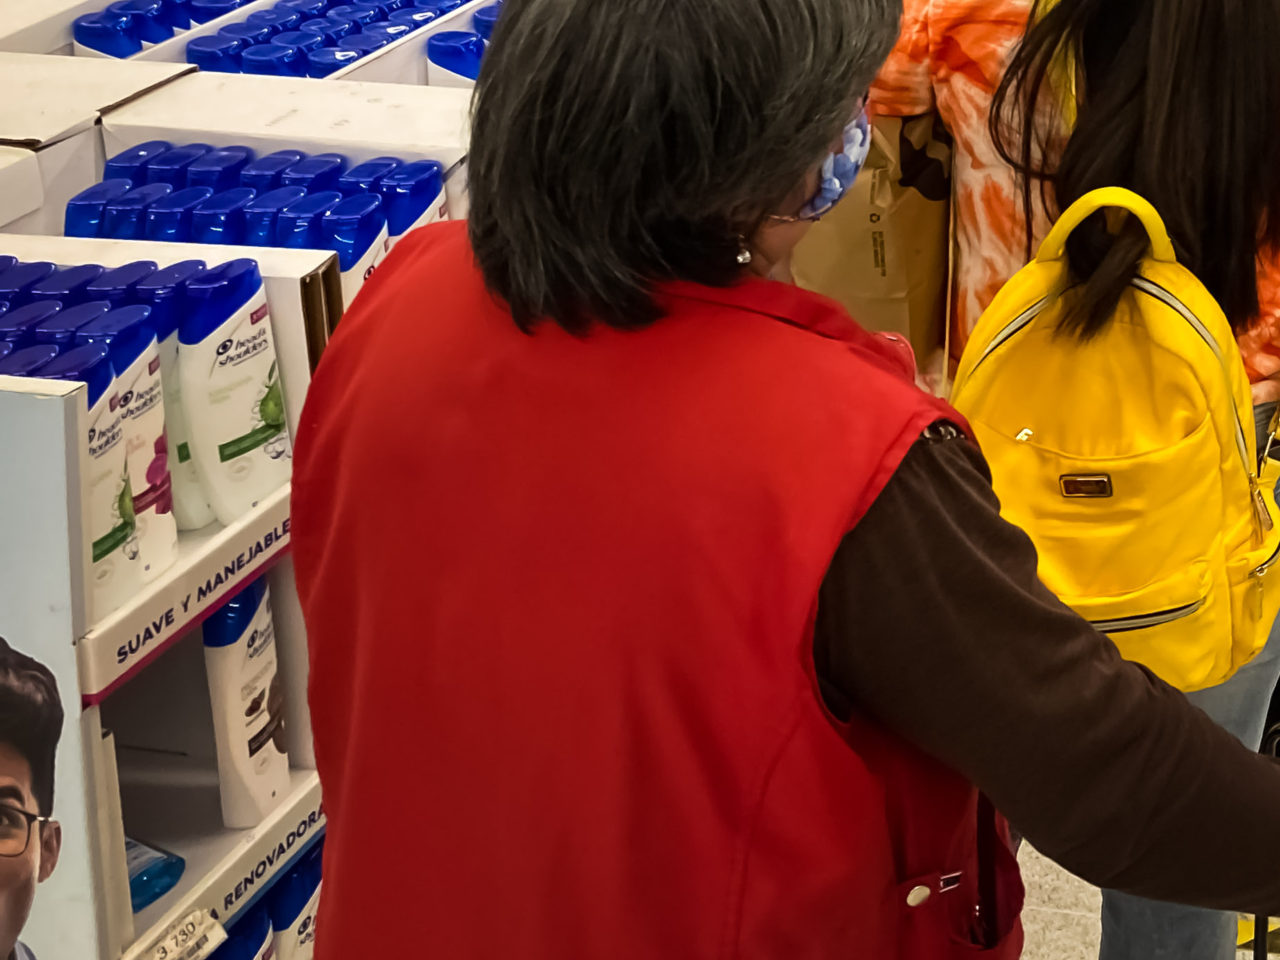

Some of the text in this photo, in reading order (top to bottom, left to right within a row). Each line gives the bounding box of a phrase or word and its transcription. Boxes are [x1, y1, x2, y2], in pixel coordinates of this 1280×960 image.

[88, 427, 123, 457] houlders
[116, 517, 291, 664] SUAVE Y MANEJABLE
